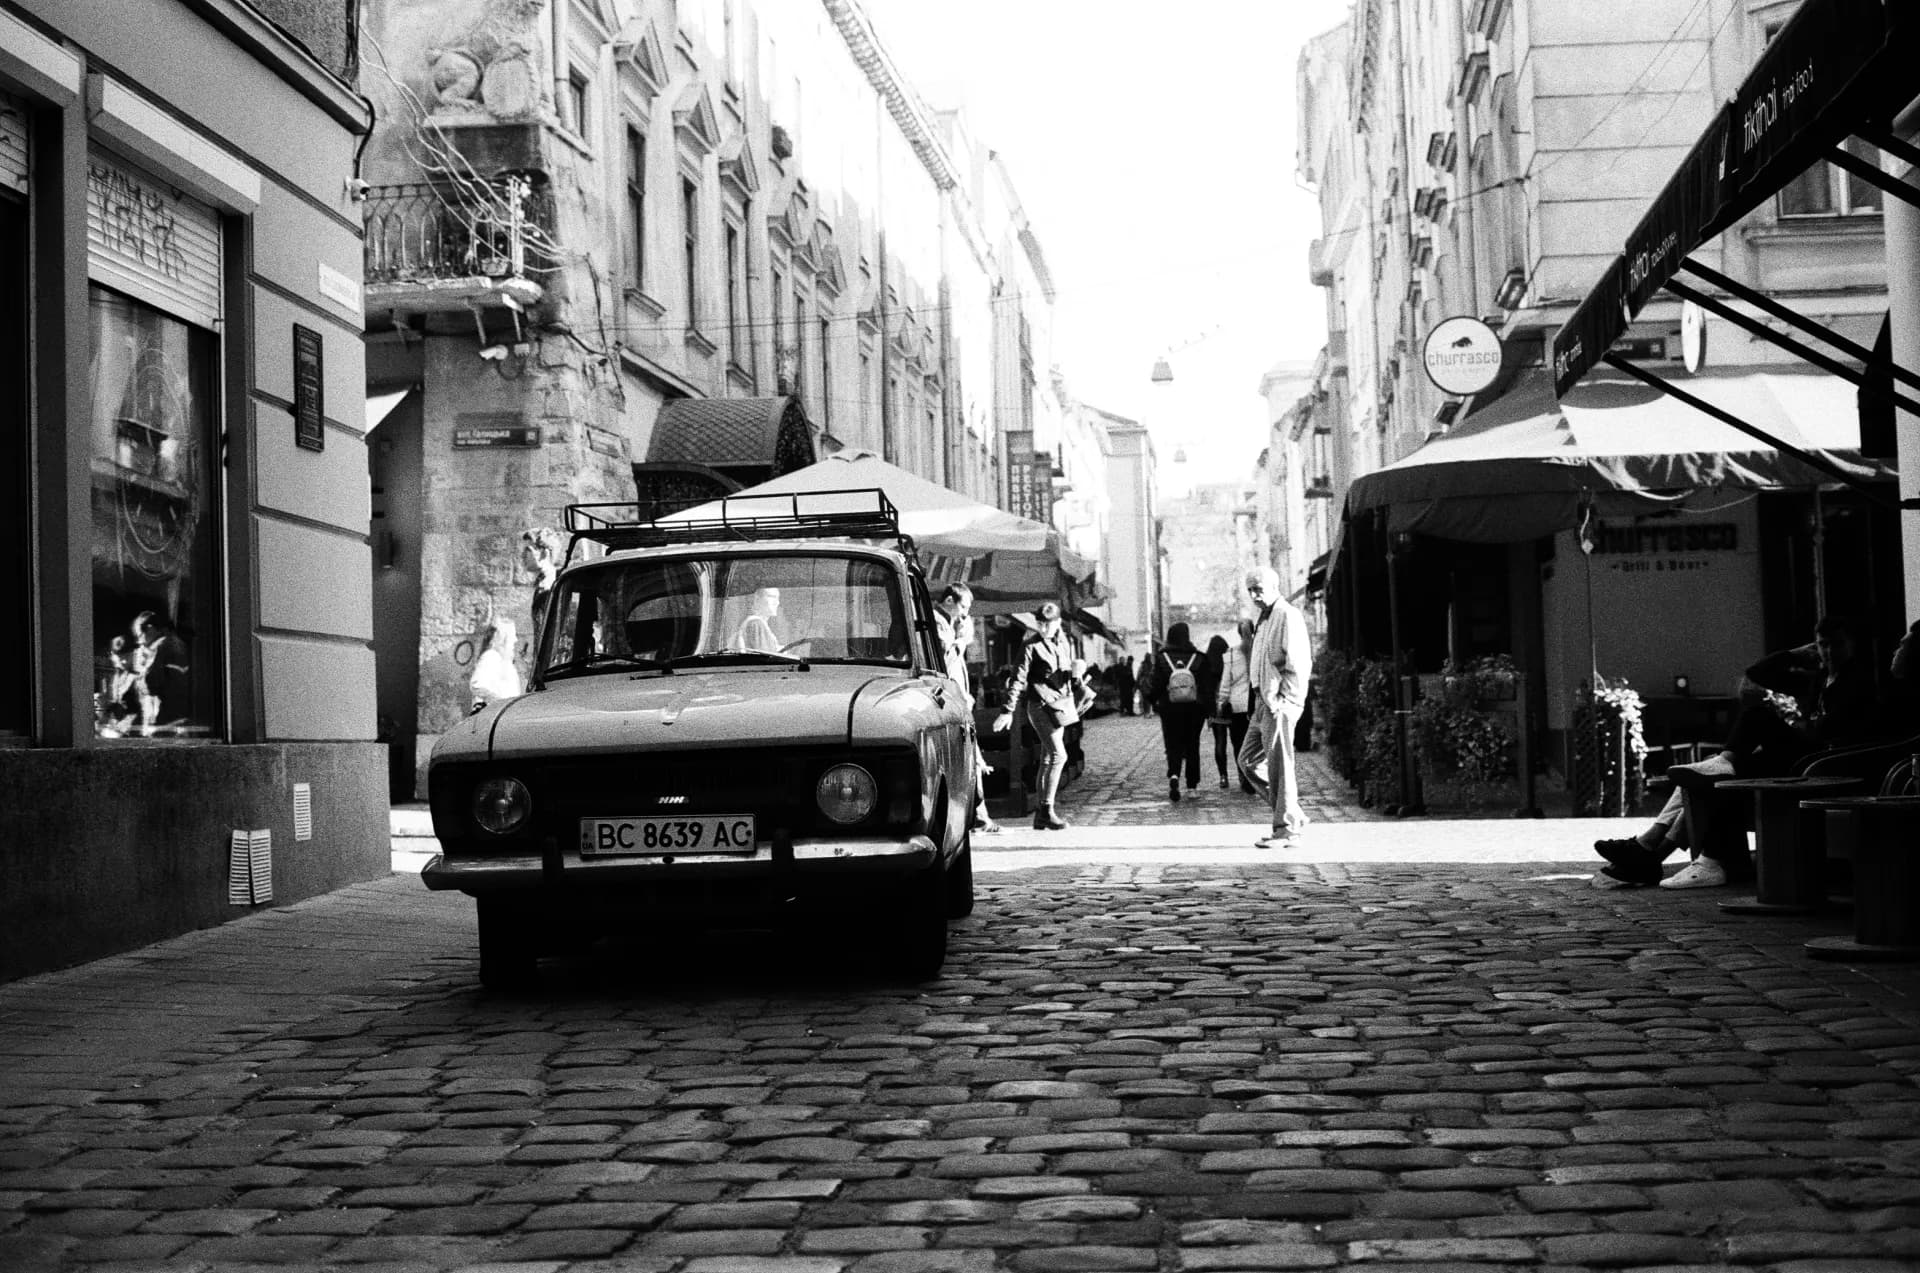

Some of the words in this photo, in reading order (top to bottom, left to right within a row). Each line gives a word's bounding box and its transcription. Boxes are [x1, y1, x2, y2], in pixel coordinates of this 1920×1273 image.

[1427, 352, 1499, 367] churrasco
[598, 823, 635, 849] BC
[643, 821, 703, 848] 8639
[713, 820, 749, 848] AC
